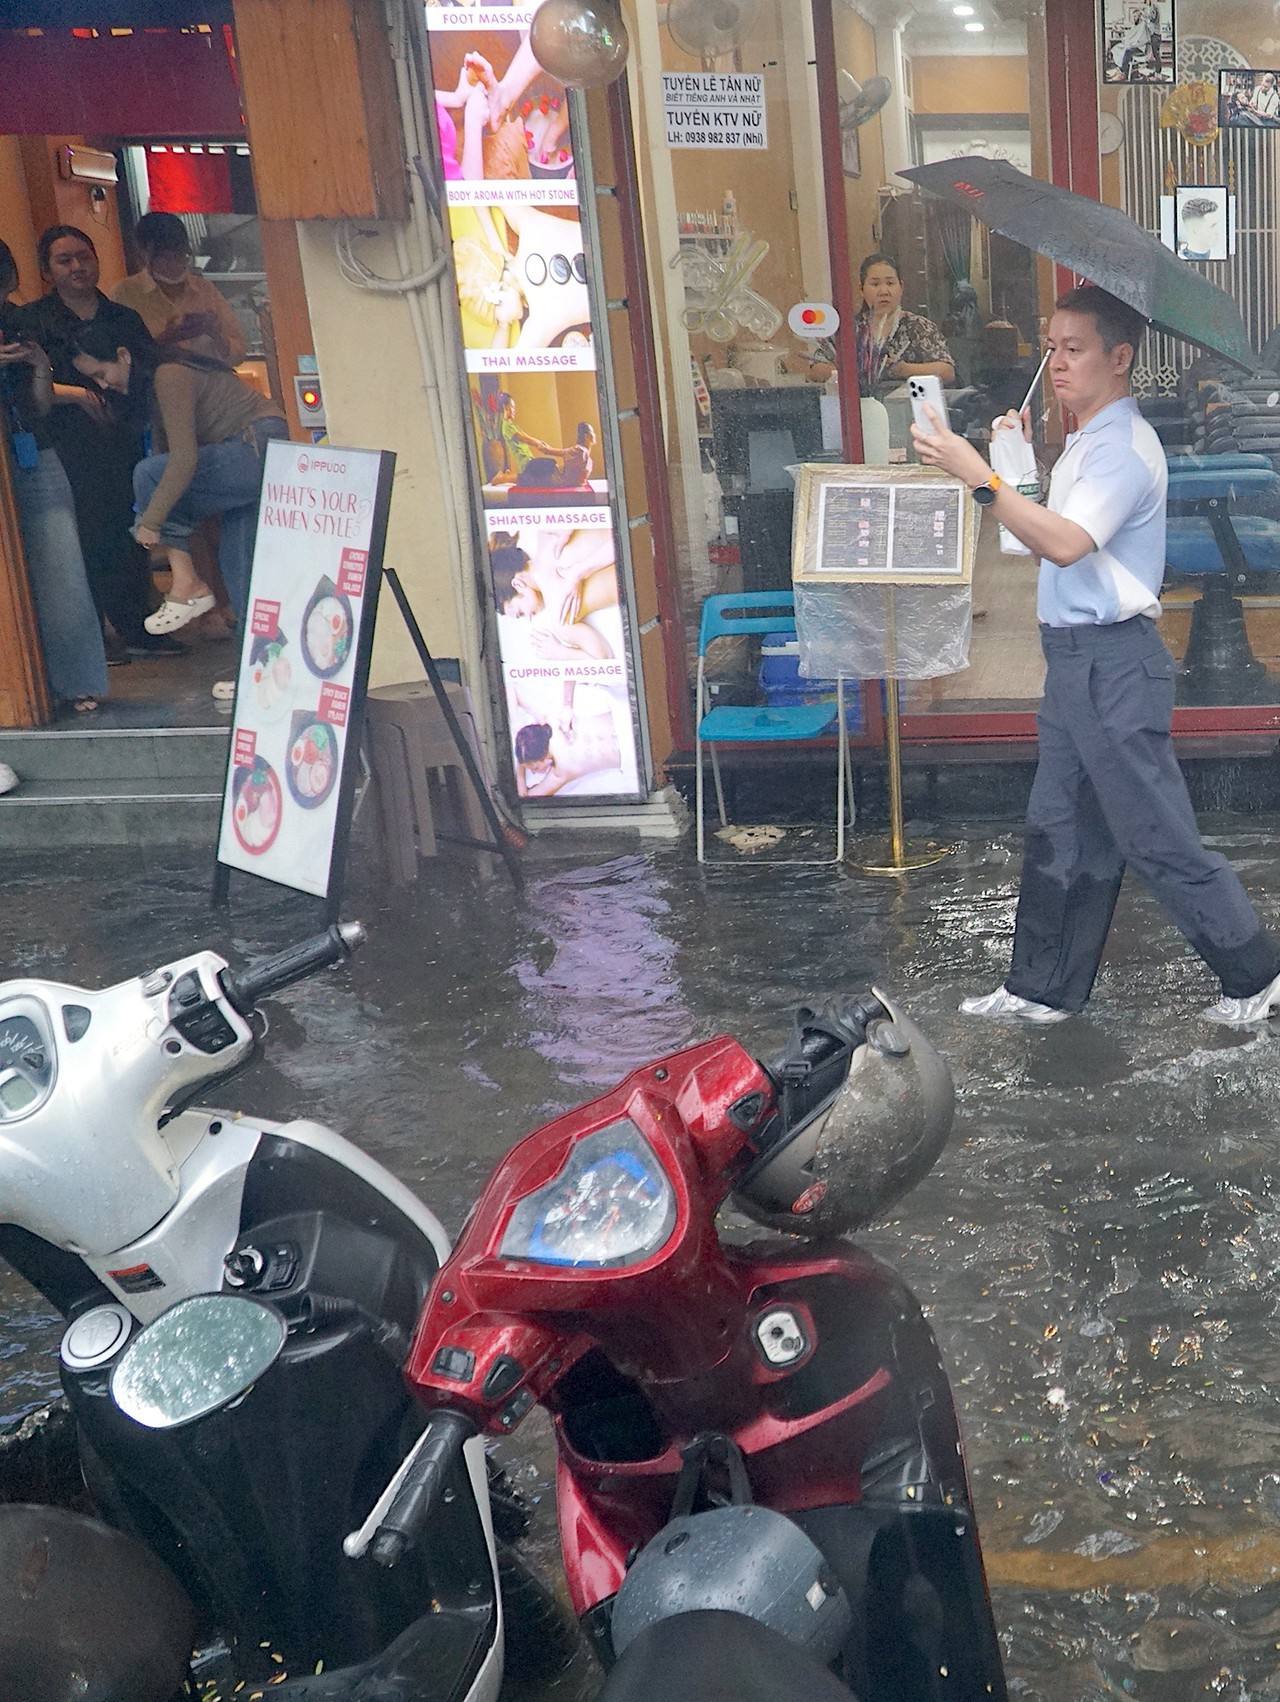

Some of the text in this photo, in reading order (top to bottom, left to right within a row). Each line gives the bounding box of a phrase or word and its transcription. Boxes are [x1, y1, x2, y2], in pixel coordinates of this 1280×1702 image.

[443, 12, 534, 24] FOOT MASSAG
[662, 74, 762, 92] TUYỂN LỄ TÂN NỮ
[709, 95, 726, 103] ANH
[727, 93, 738, 103] VÀ
[666, 108, 762, 127] TUYỂN KTV NỮ
[667, 131, 763, 146] LH: 0938 982 837 (Nhi)
[448, 189, 575, 201] BODY AROMA WITH HOT STONE
[481, 355, 577, 367] THAI MASSAGE
[311, 460, 347, 474] IPPUDO
[267, 482, 357, 514] WHAT'S YOUR
[264, 505, 310, 531] RAMEN
[489, 513, 606, 526] SHIATSU MASSAGE
[509, 665, 622, 678] CUPPING MASSAGE
